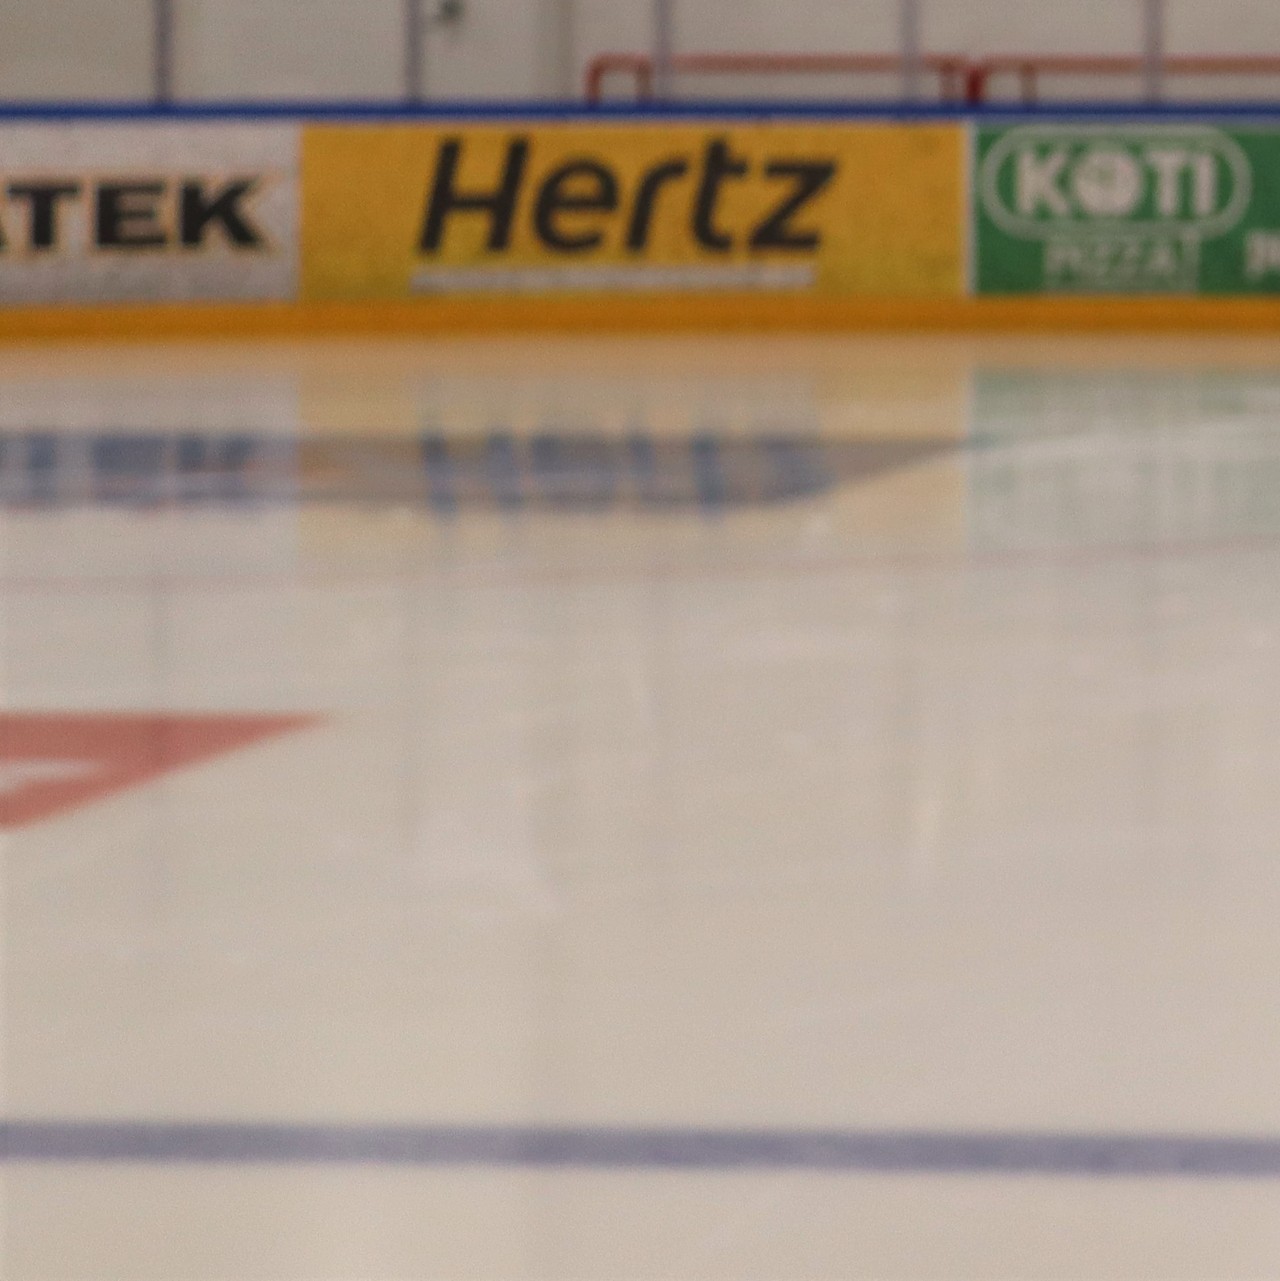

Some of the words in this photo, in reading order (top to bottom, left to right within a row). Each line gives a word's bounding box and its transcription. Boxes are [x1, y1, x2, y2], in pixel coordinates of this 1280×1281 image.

[0, 177, 267, 252] TEK
[417, 133, 838, 255] Hertz
[1012, 148, 1218, 219] KOTI
